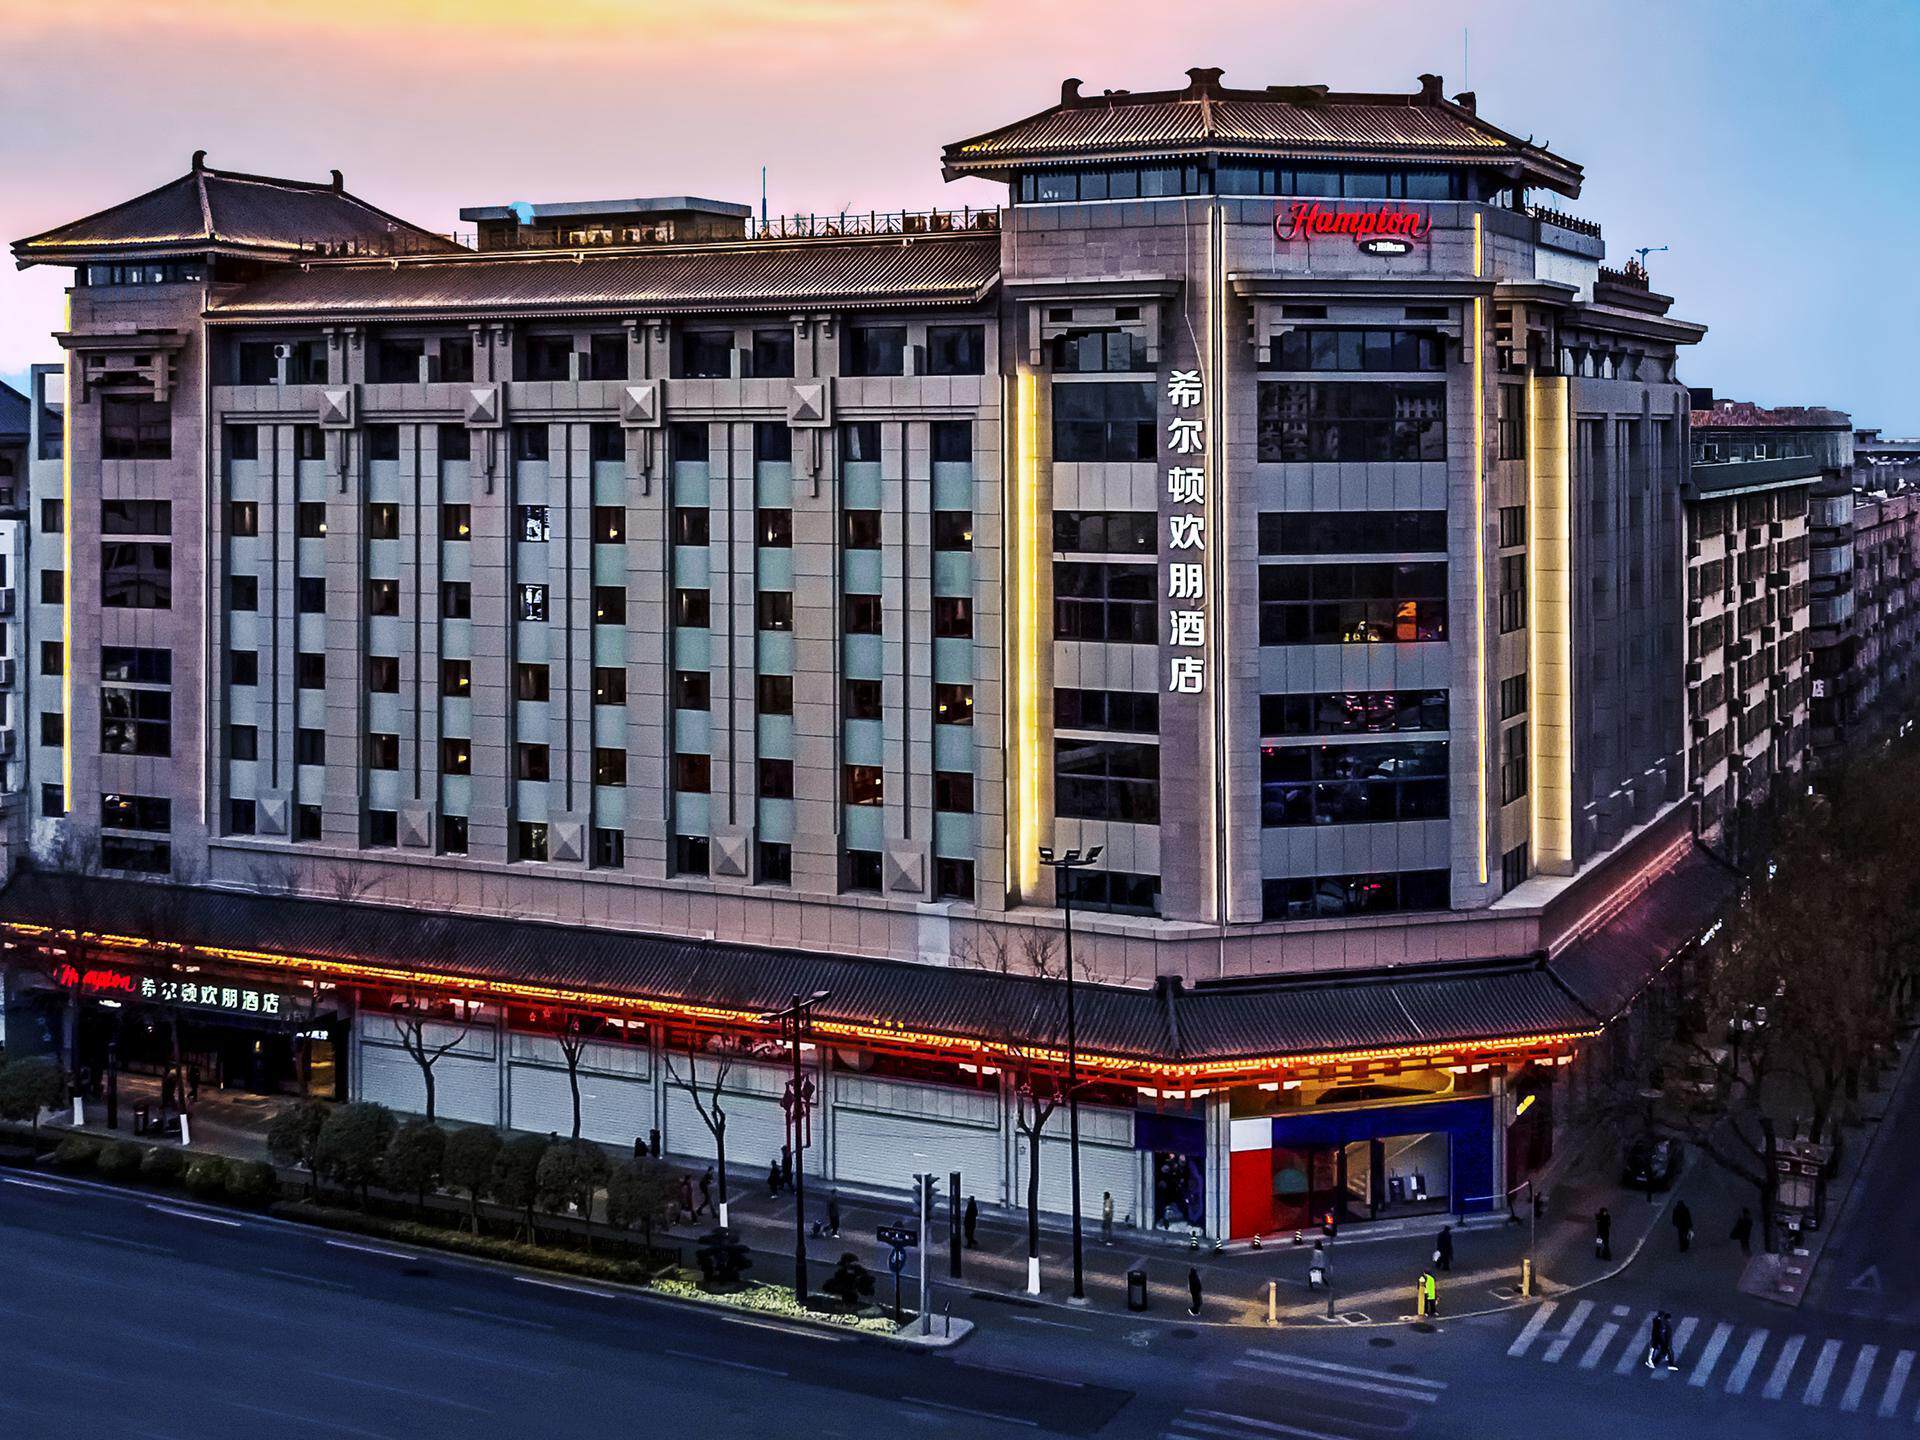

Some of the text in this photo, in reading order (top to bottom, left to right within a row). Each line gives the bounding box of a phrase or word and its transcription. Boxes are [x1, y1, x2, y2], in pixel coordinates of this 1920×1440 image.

[1275, 201, 1432, 242] Hampton
[1167, 370, 1205, 694] 希尔顿欢朋酒店
[141, 976, 280, 1014] 希尔顿欢朋酒店
